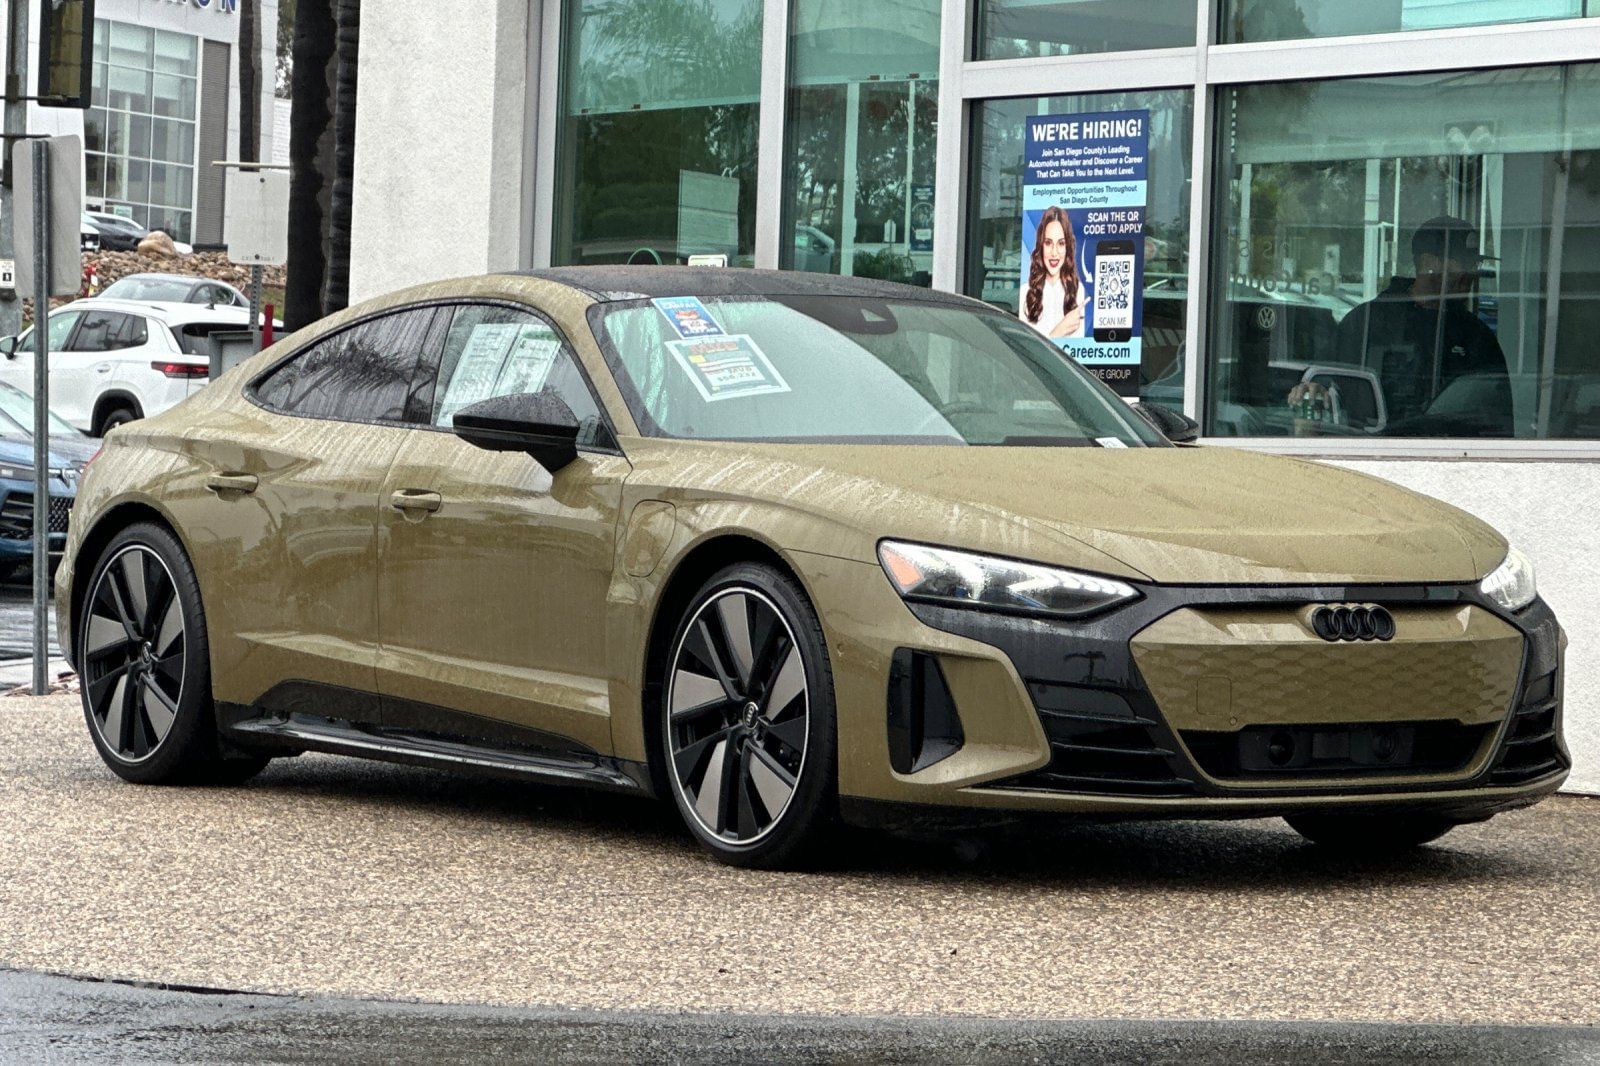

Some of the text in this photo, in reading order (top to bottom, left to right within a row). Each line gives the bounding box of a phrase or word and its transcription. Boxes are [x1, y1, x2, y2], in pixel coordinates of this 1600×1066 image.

[1032, 119, 1142, 142] WE'RE HIRING!
[1042, 145, 1130, 157] Join San Diego County's Leading
[1029, 159, 1059, 168] Automotive
[1060, 158, 1081, 167] Retailer
[1082, 157, 1093, 166] and
[1094, 156, 1119, 165] Discover
[1124, 155, 1143, 164] Career
[1036, 167, 1134, 178] That Can Take You to the Next Level.
[1032, 185, 1138, 197] Employment Opportunities Throughout
[1071, 196, 1088, 205] Diego
[1089, 195, 1108, 204] County
[1088, 211, 1139, 222] SCAN THE QR
[1083, 223, 1143, 235] CODE TO APPLY
[1098, 317, 1127, 326] SCAN ME
[1105, 369, 1131, 380] GROUP
